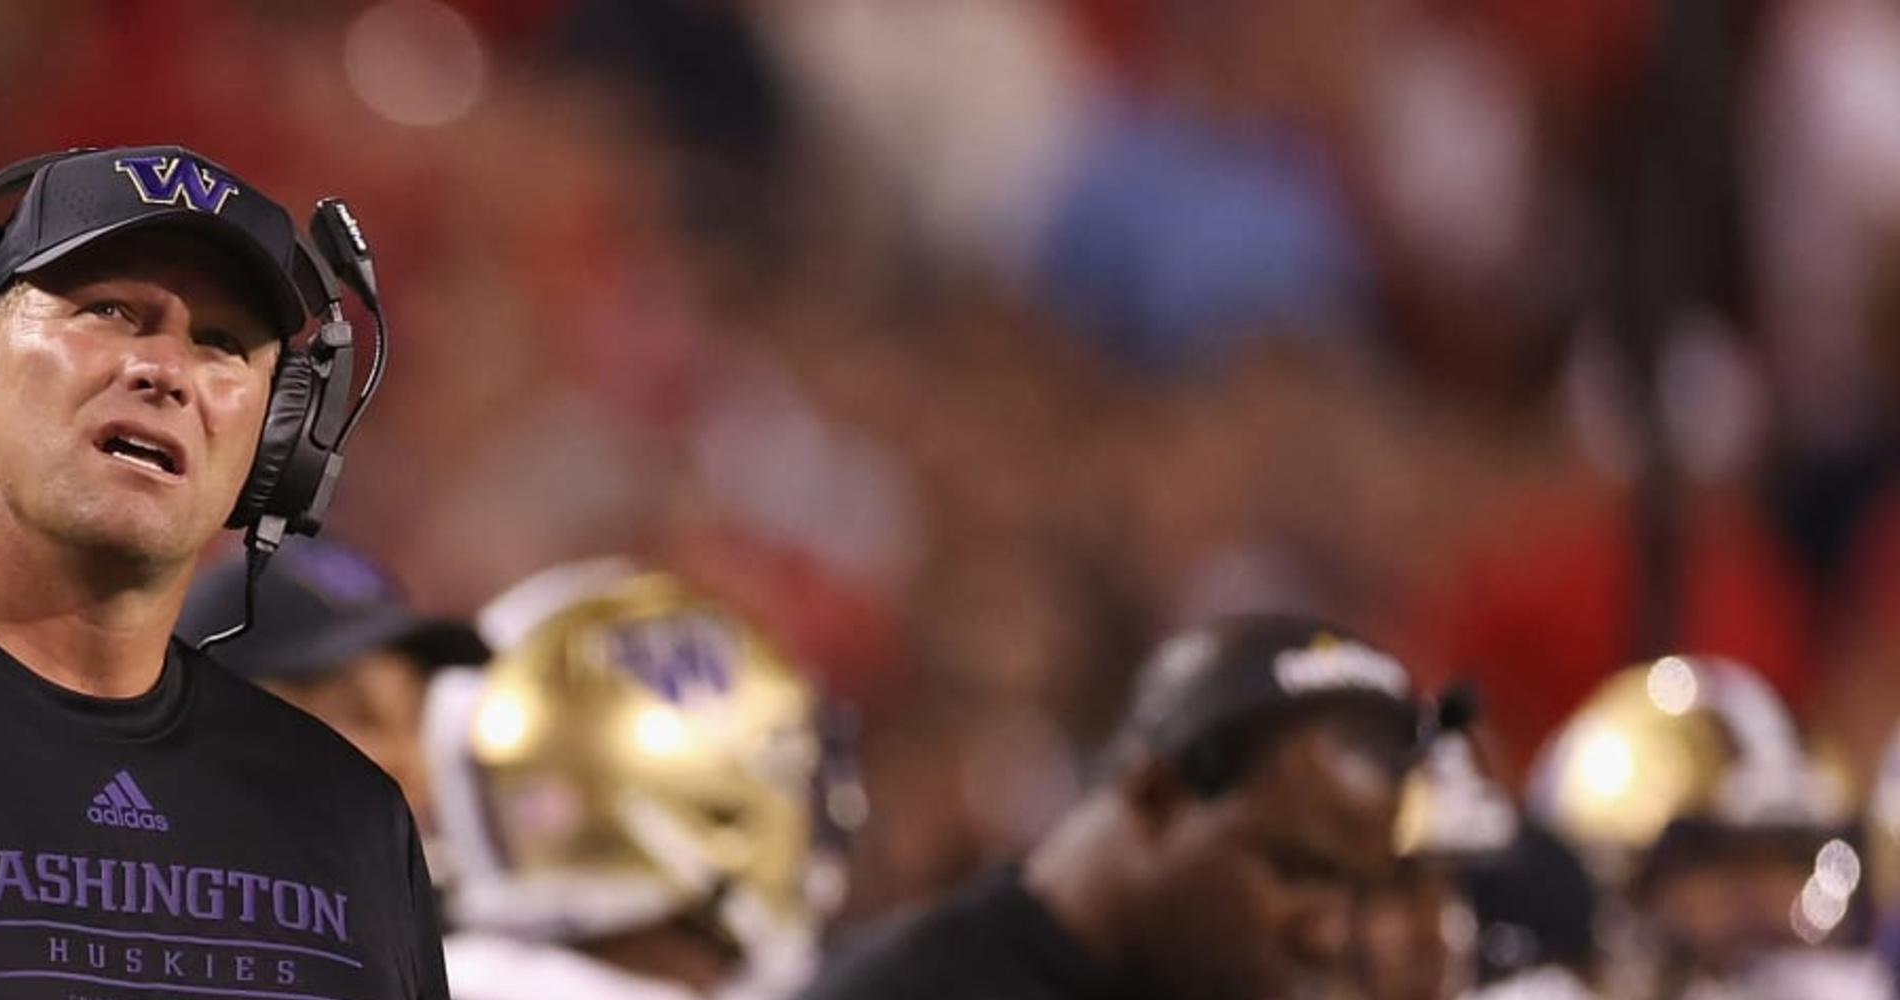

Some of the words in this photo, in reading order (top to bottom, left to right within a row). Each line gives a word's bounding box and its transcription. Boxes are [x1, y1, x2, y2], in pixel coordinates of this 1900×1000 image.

[114, 156, 240, 215] W
[87, 805, 169, 832] adidas
[49, 936, 296, 986] HUSKIES
